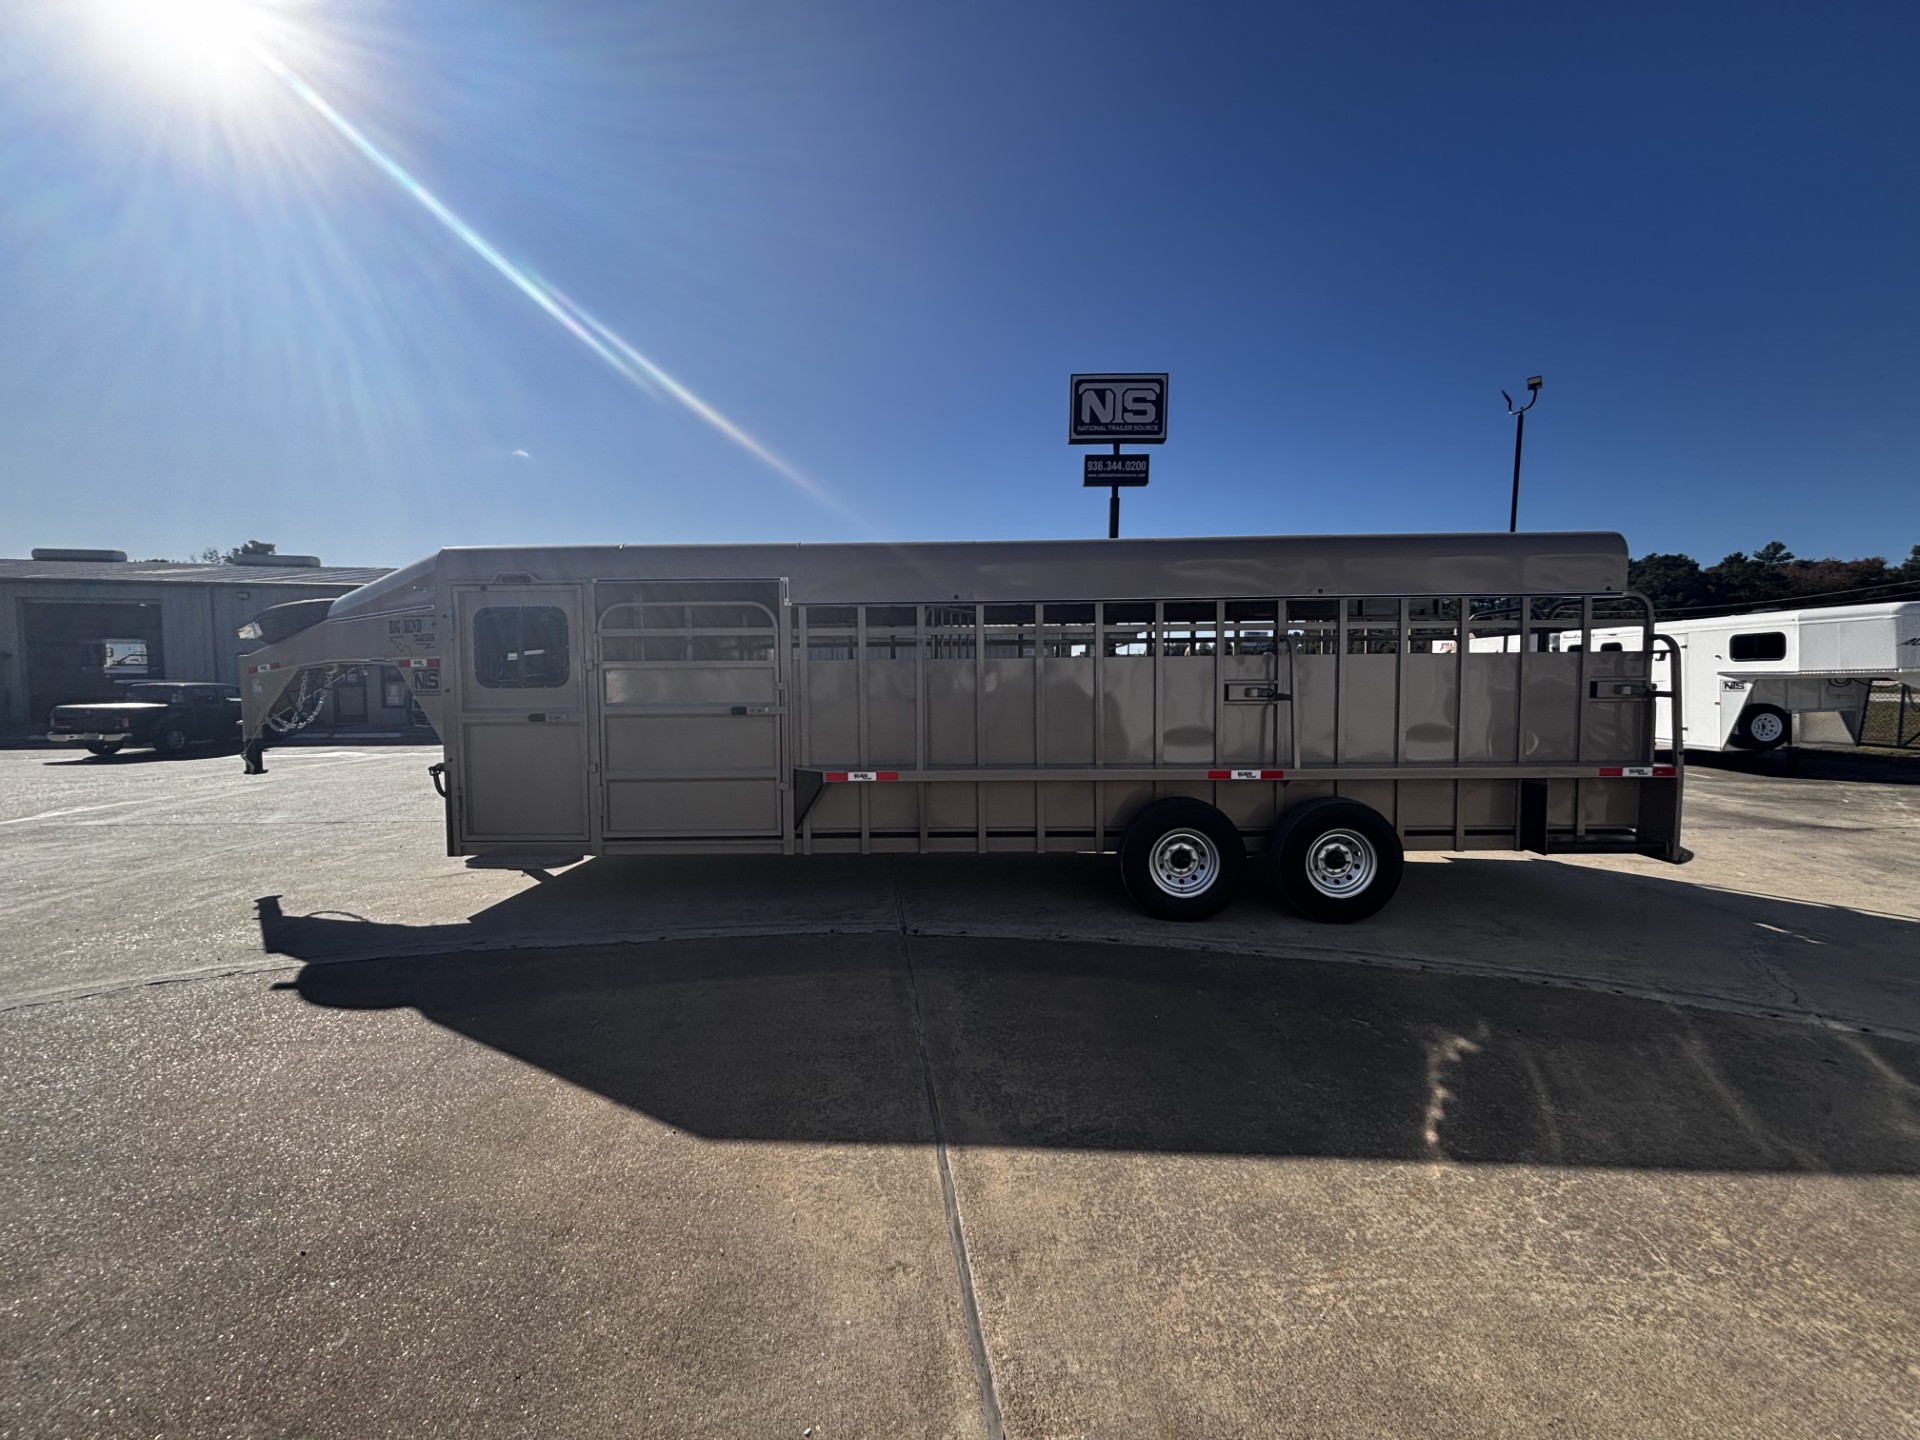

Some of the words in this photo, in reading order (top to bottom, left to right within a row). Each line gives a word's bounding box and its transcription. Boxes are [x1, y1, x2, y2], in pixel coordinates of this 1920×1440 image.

[1079, 383, 1160, 423] NTS
[1087, 461, 1147, 471] 936.344.0200
[413, 669, 440, 689] NTS
[1723, 680, 1747, 689] NTS
